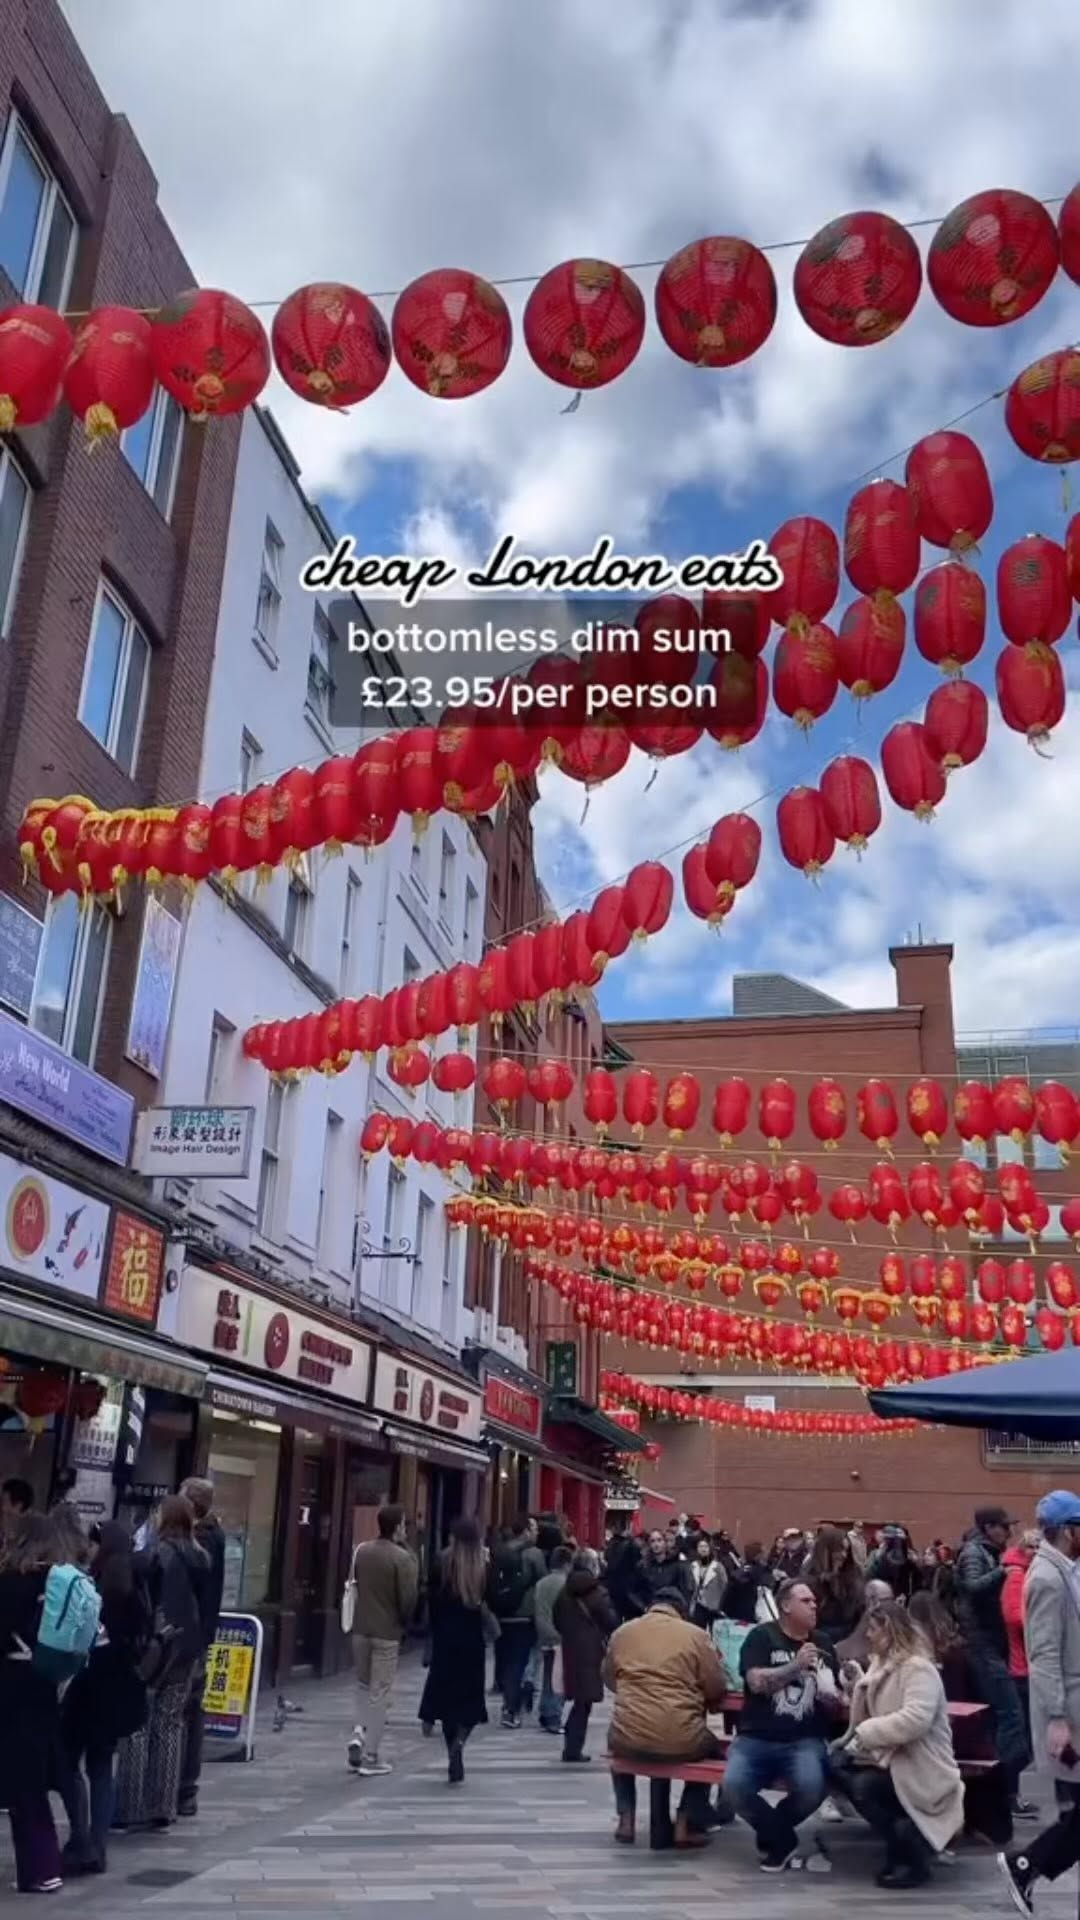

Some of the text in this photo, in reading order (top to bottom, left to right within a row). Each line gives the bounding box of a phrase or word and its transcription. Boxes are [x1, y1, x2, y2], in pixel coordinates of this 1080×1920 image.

[150, 1144, 241, 1156] Image Hair Design
